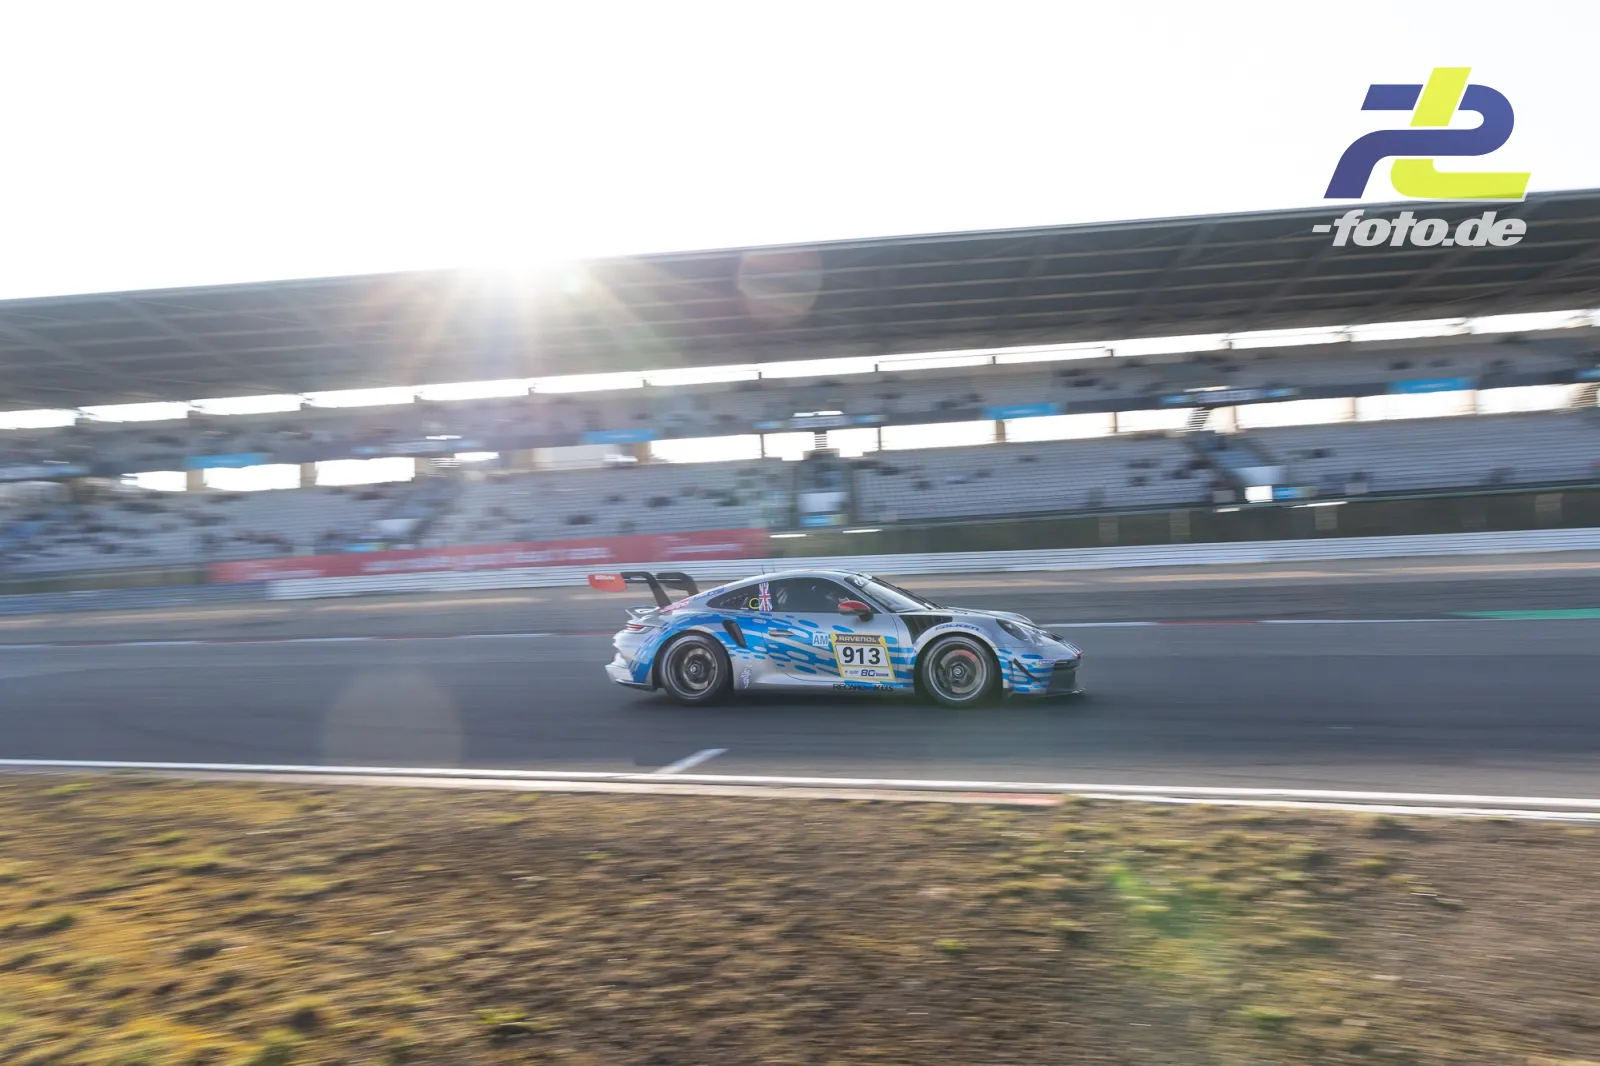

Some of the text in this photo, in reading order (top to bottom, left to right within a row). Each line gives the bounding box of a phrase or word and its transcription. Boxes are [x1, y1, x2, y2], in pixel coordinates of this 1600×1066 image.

[813, 634, 829, 645] AM
[838, 635, 877, 643] RAVENOL
[842, 646, 881, 665] 913
